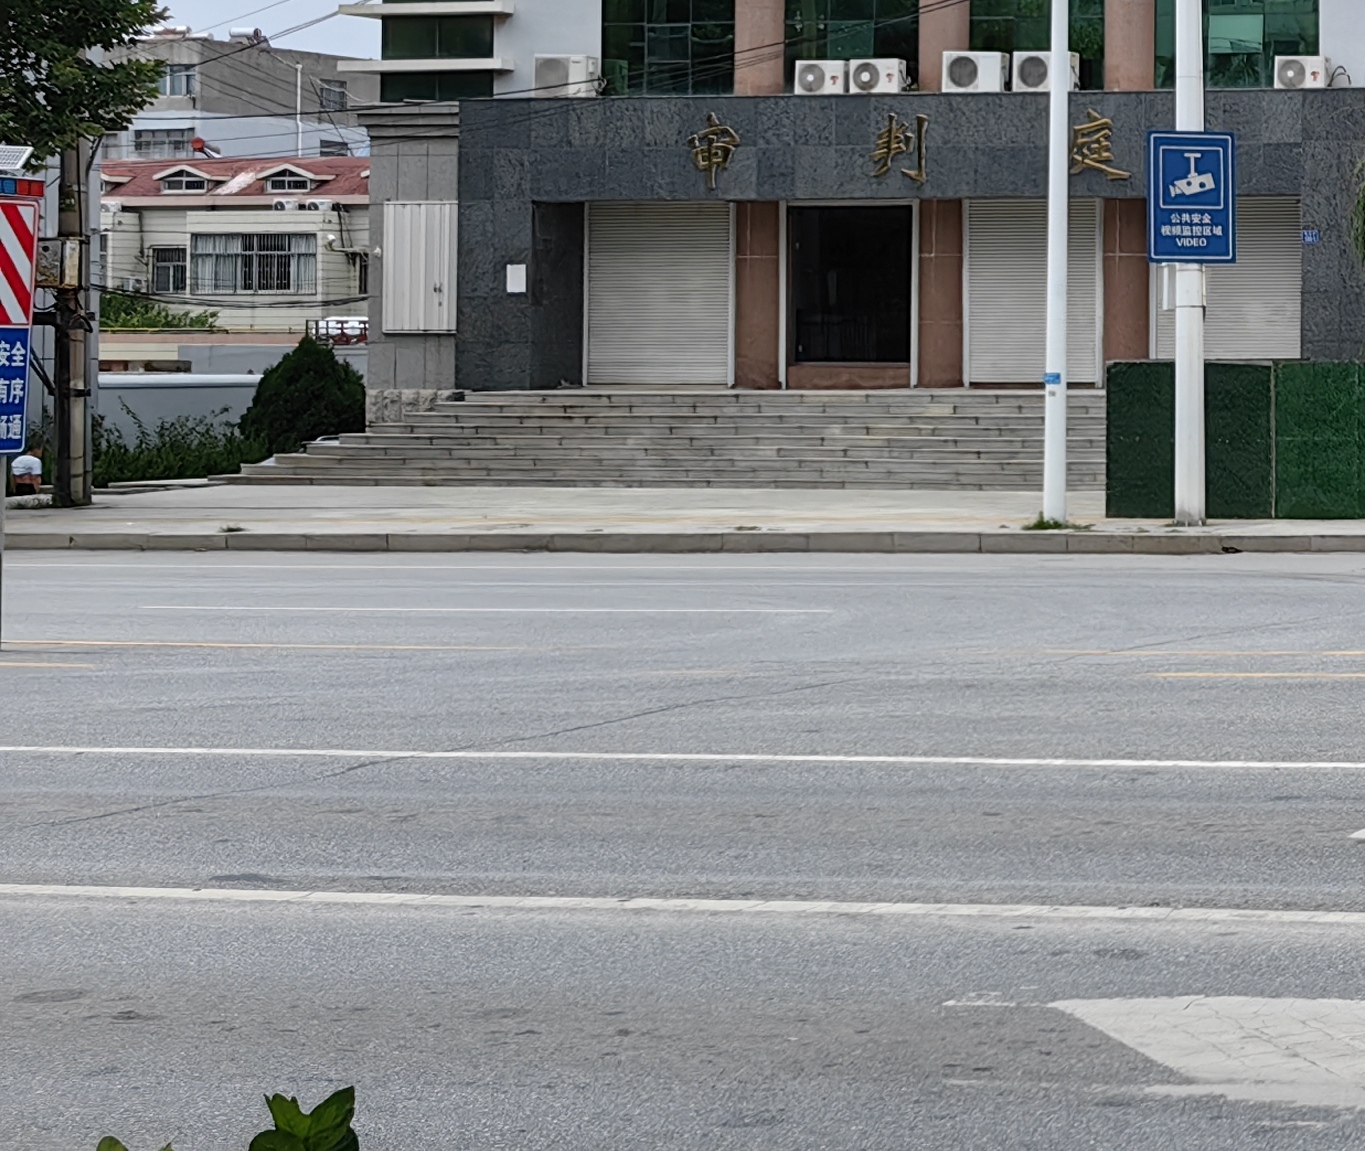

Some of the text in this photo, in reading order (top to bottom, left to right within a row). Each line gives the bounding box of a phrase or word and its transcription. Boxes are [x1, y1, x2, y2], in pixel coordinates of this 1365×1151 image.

[687, 109, 1132, 190] 审判庭
[1170, 212, 1212, 224] 公共安全
[1161, 224, 1223, 236] 视频监控区域
[1176, 237, 1207, 247] VIDEO
[0, 340, 26, 367] 安全
